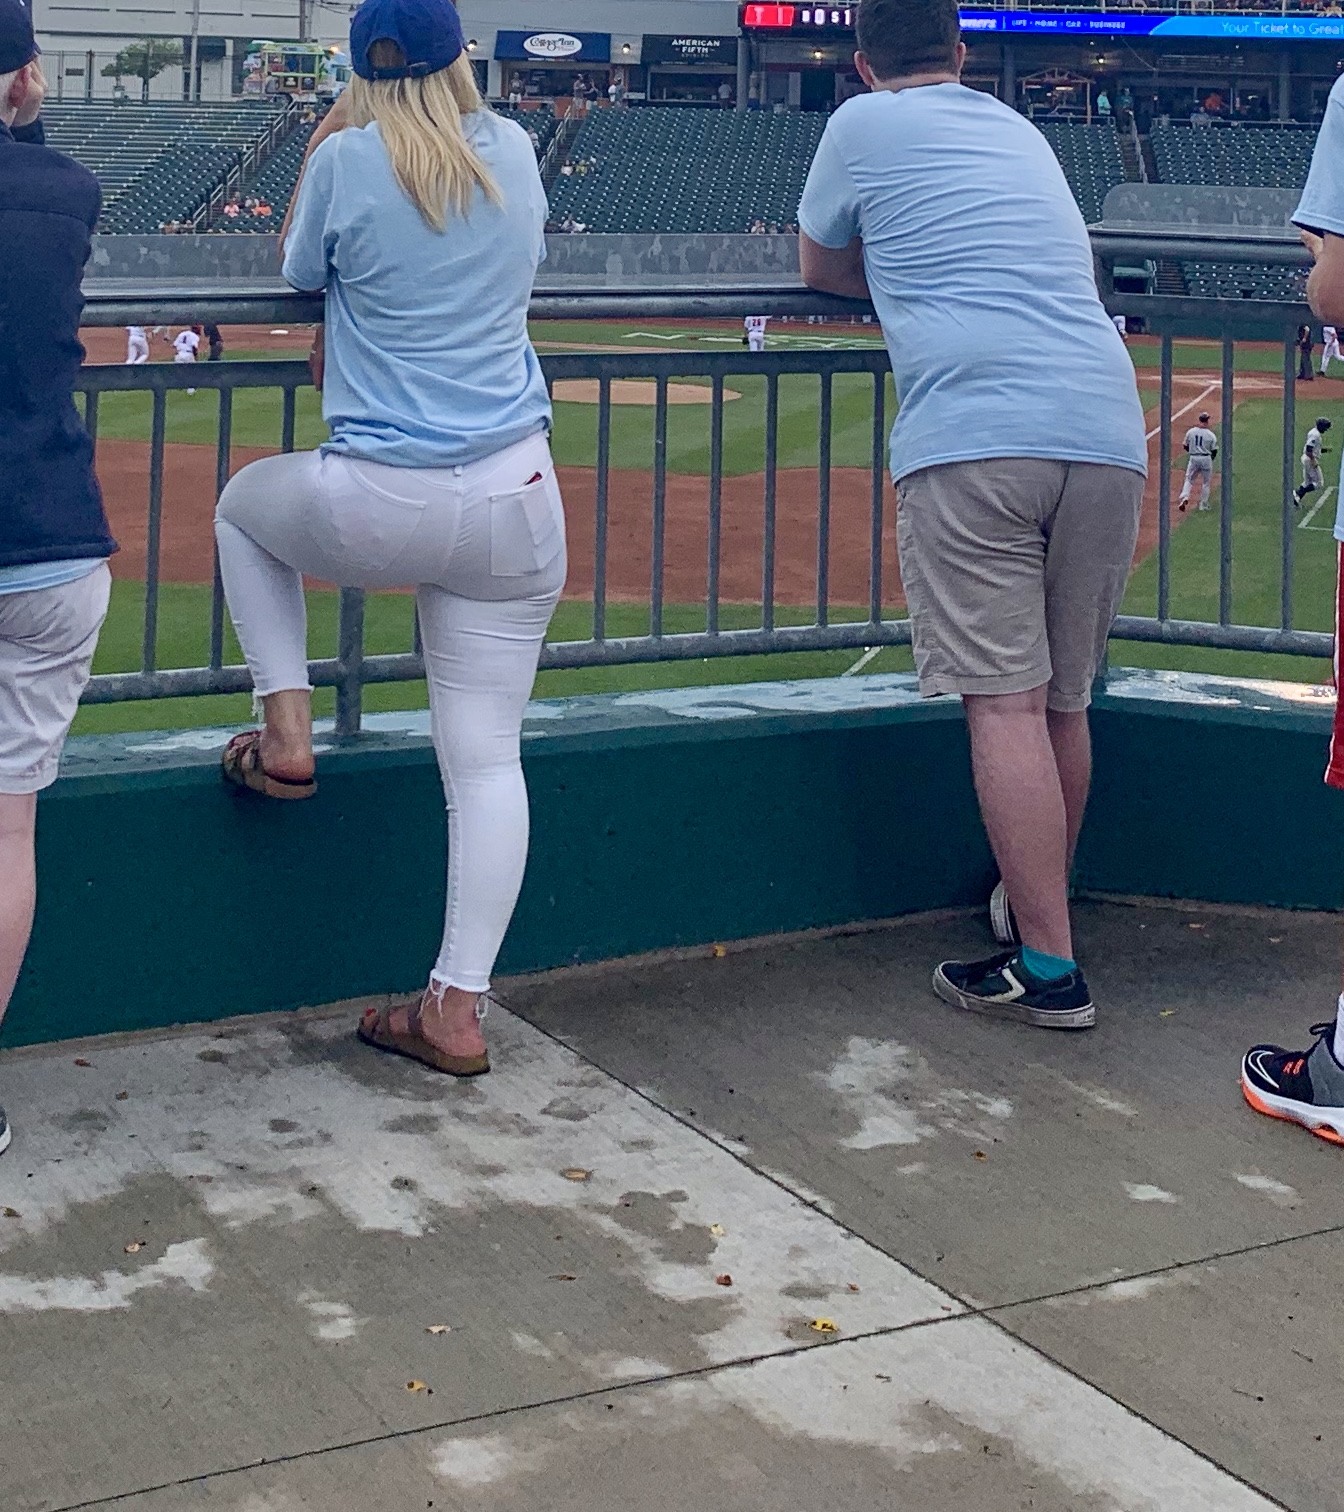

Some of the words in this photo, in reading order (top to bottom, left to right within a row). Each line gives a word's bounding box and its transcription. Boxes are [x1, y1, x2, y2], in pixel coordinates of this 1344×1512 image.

[1221, 21, 1249, 33] Your
[1255, 21, 1288, 34] Ticket
[1293, 23, 1305, 35] to
[1309, 23, 1344, 35] Great
[671, 39, 721, 47] AMERICAN
[1195, 435, 1203, 446] 11
